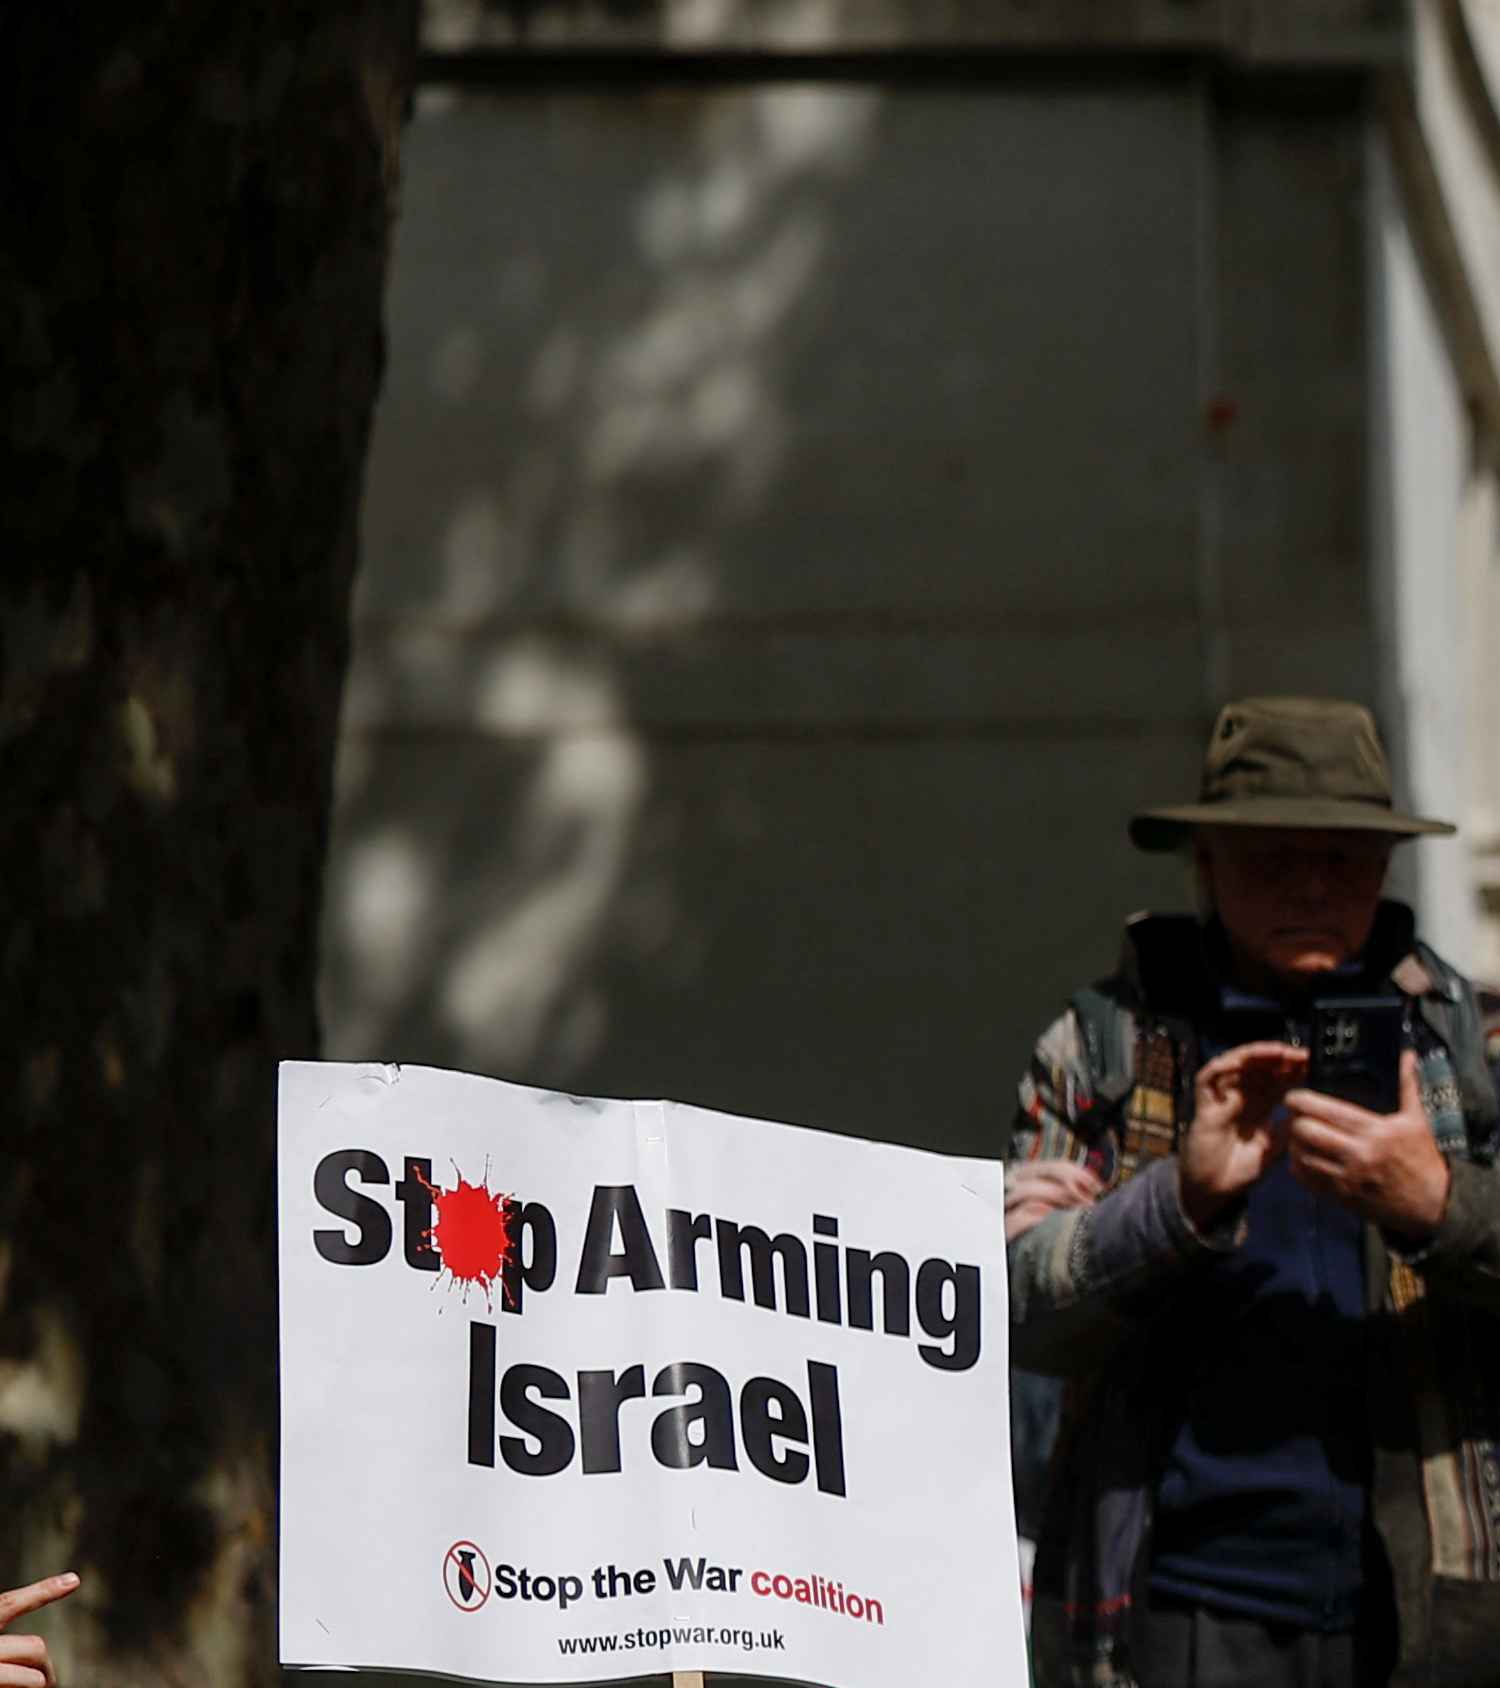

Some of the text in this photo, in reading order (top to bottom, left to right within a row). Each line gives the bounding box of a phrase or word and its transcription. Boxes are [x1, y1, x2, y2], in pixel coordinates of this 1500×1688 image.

[575, 1185, 981, 1371] Arming
[467, 1322, 847, 1498] Israel
[494, 1557, 884, 1626] Stop the War coalition
[558, 1626, 786, 1656] www.stopwar.org.uk
